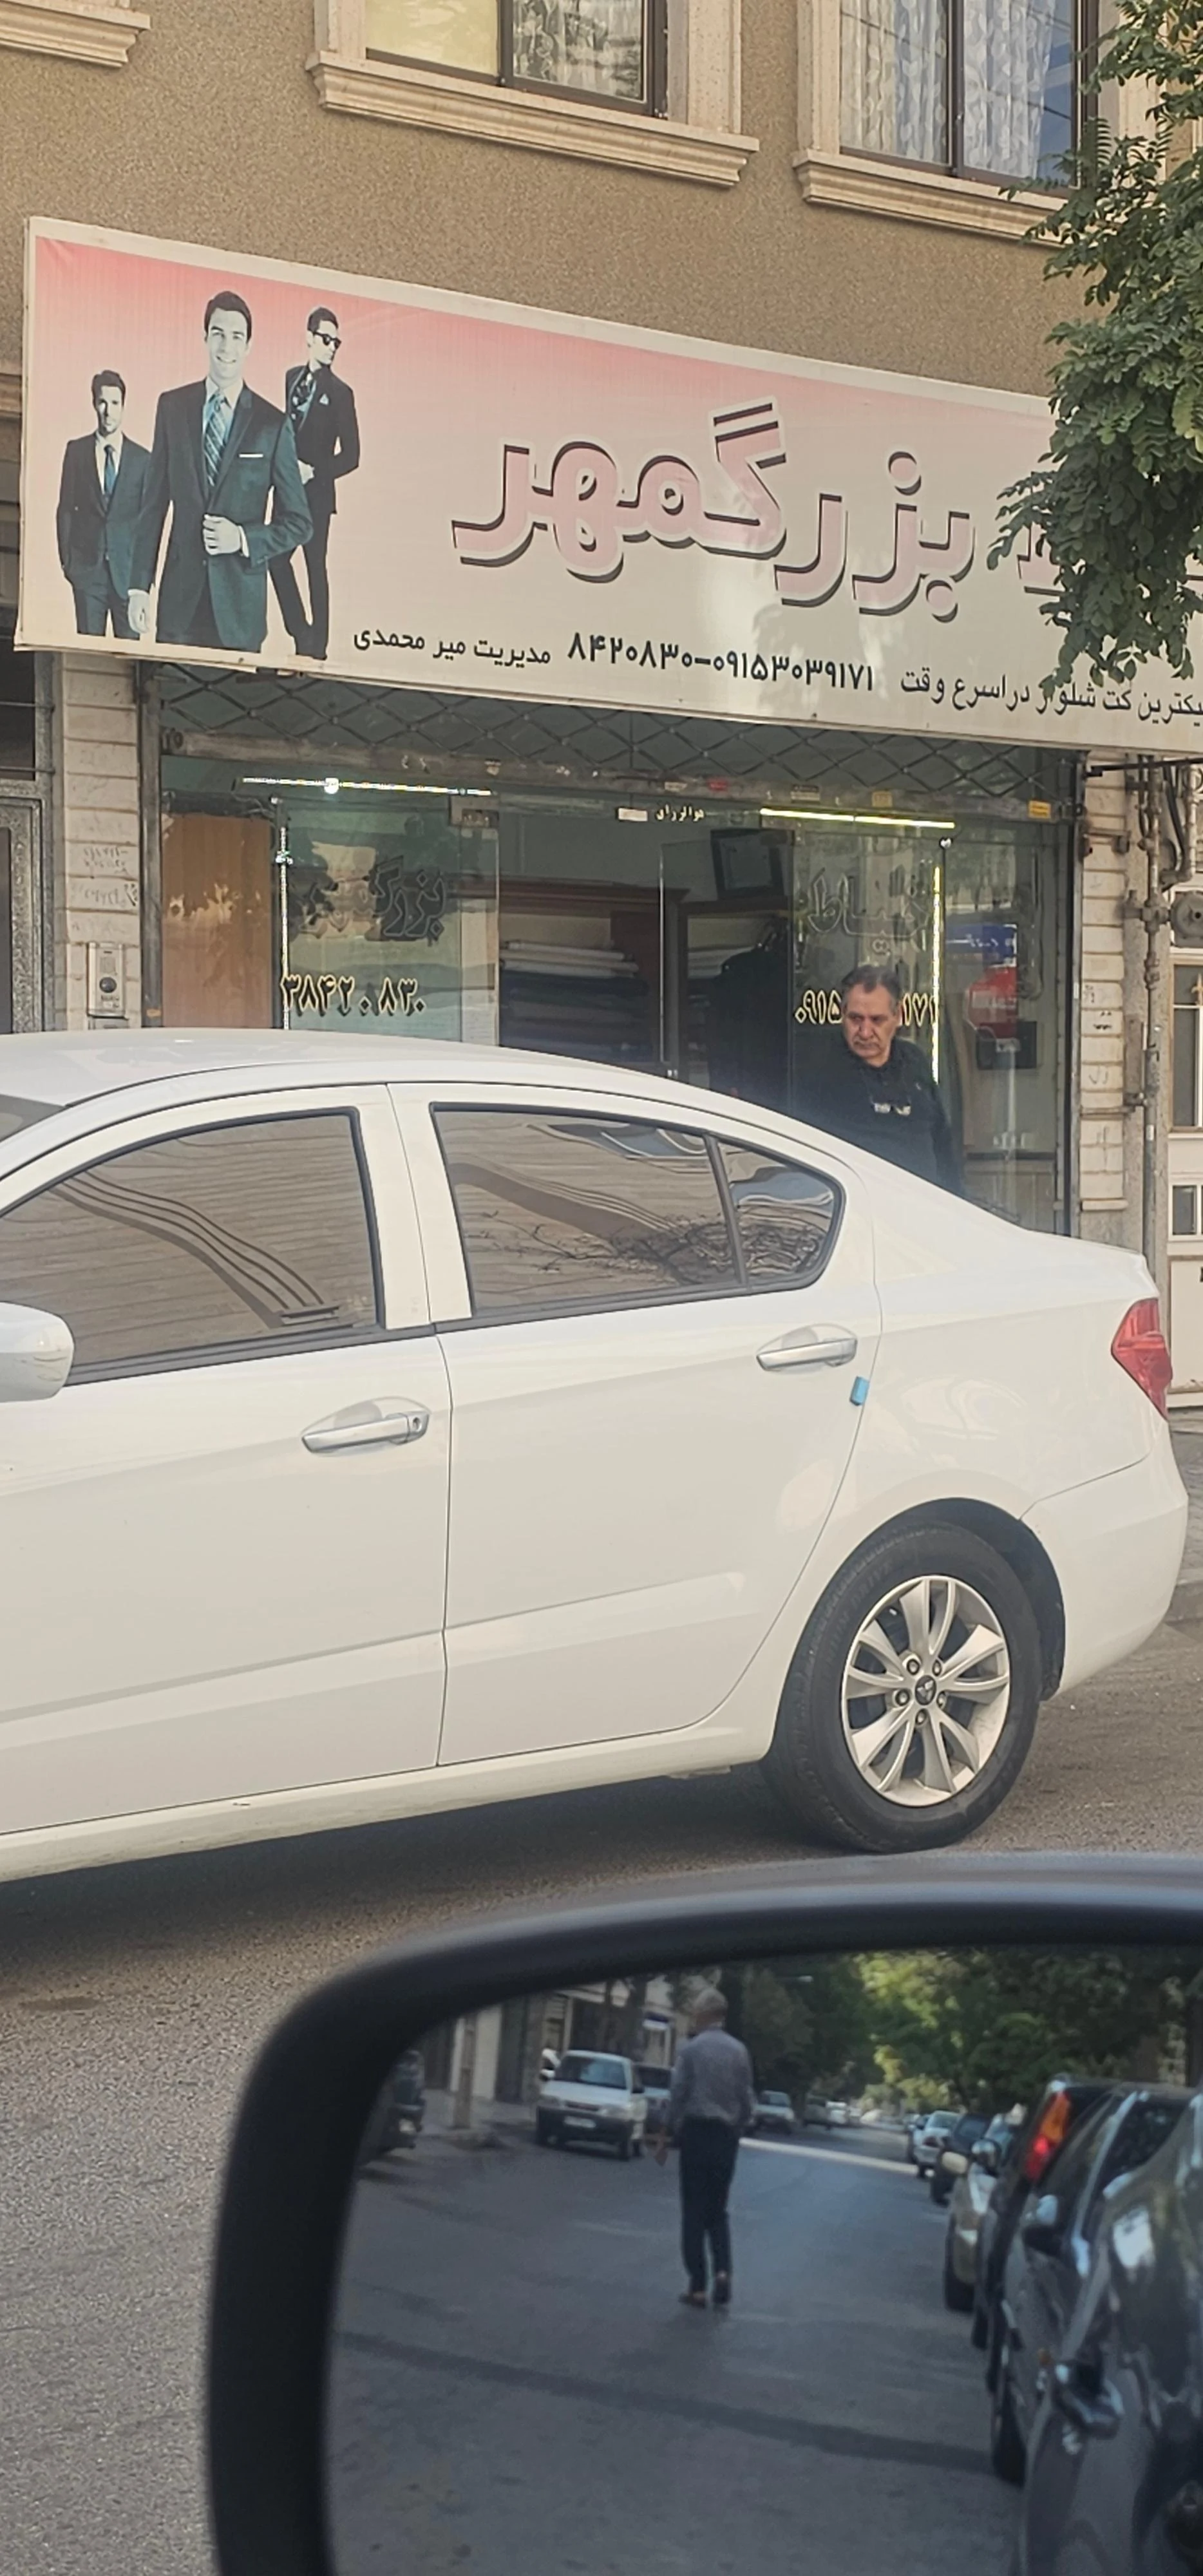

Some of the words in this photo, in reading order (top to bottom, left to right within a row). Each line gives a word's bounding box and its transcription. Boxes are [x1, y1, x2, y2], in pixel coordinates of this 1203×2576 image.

[452, 401, 975, 621] بزرگمهر
[354, 629, 426, 651] محمدی
[432, 639, 466, 661] میر
[473, 639, 551, 668] مدیریت
[900, 667, 945, 705] وقت
[1036, 682, 1095, 715] شلور
[1103, 689, 1132, 710] کت
[280, 974, 426, 1014] ۳۸۴۲۰۸۳۰
